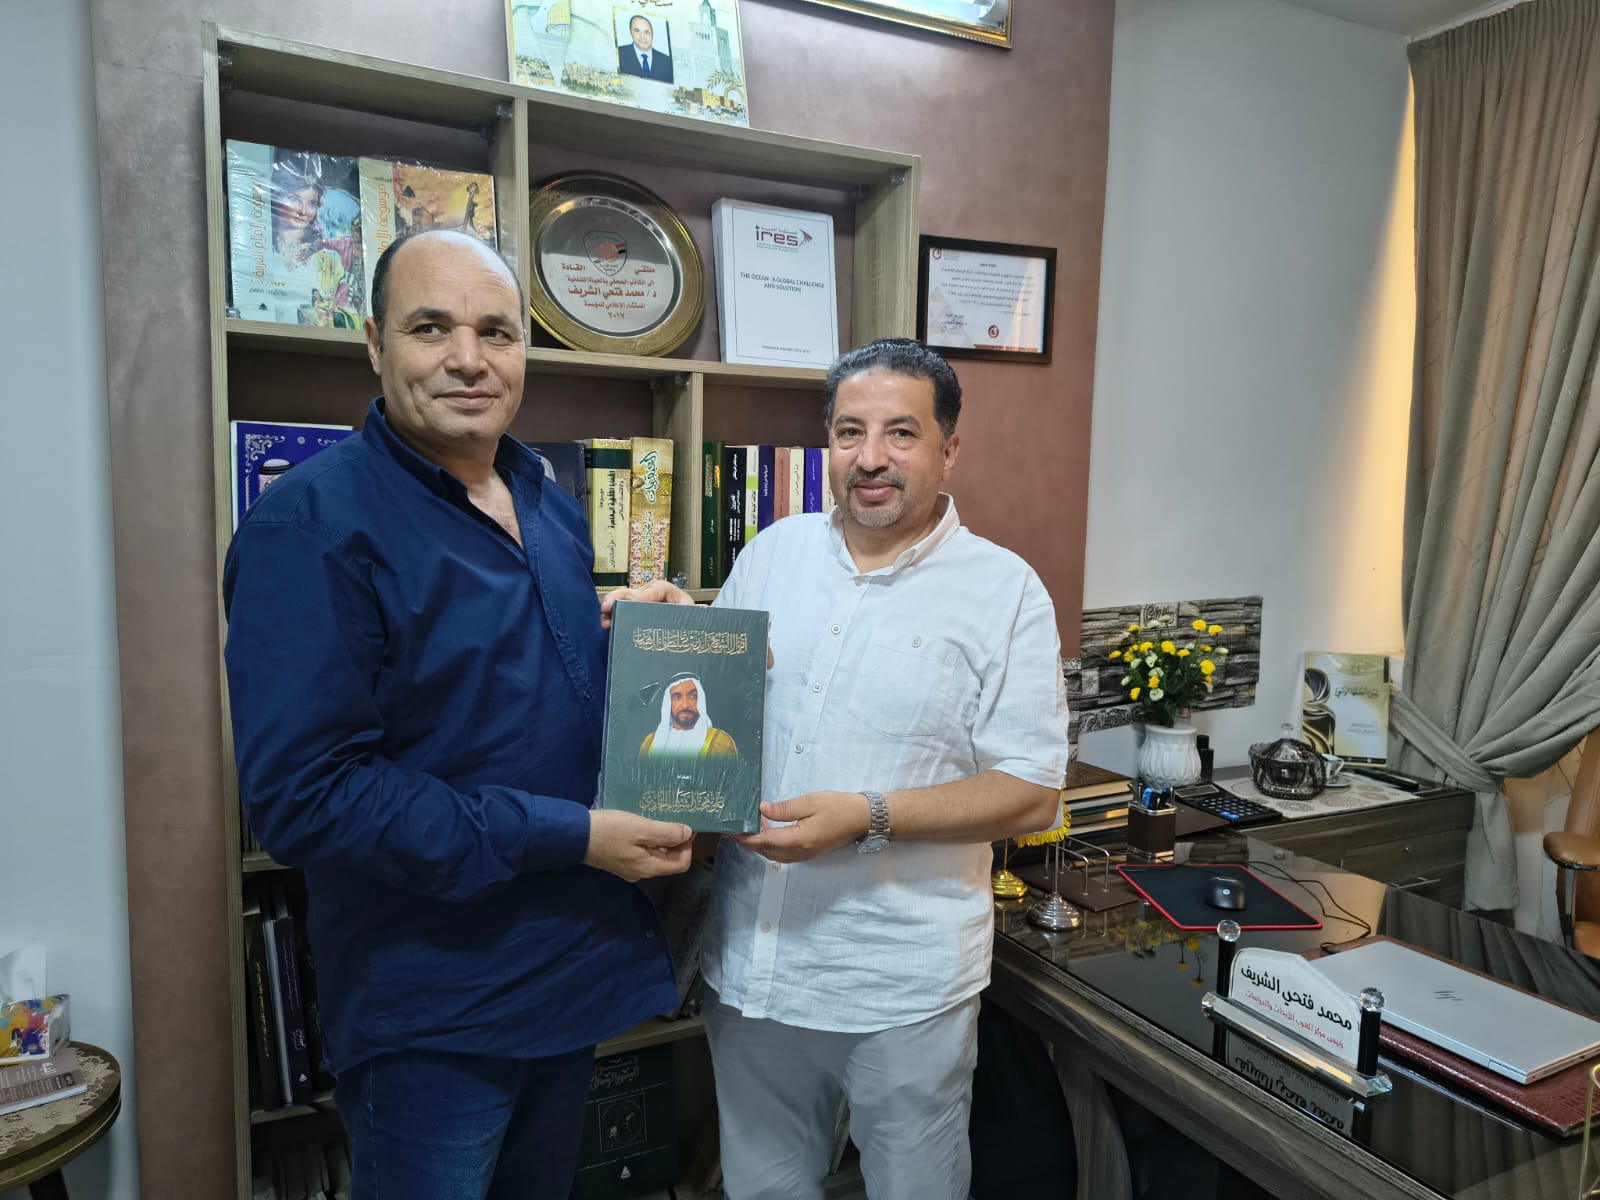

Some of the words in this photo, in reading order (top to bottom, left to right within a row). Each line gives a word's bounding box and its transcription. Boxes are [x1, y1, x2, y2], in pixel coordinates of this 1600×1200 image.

[377, 184, 391, 226] موسوعة
[755, 226, 798, 246] ires
[568, 285, 601, 298] الشريف
[797, 280, 825, 288] CHALLENGE
[603, 287, 623, 300] فتحي
[624, 289, 645, 298] محمد
[607, 312, 625, 320] ٢٠١٧
[638, 450, 661, 504] العبقريات
[1240, 965, 1281, 994] الشريف
[1281, 993, 1315, 1010] فتحي
[1317, 1005, 1353, 1031] محمد
